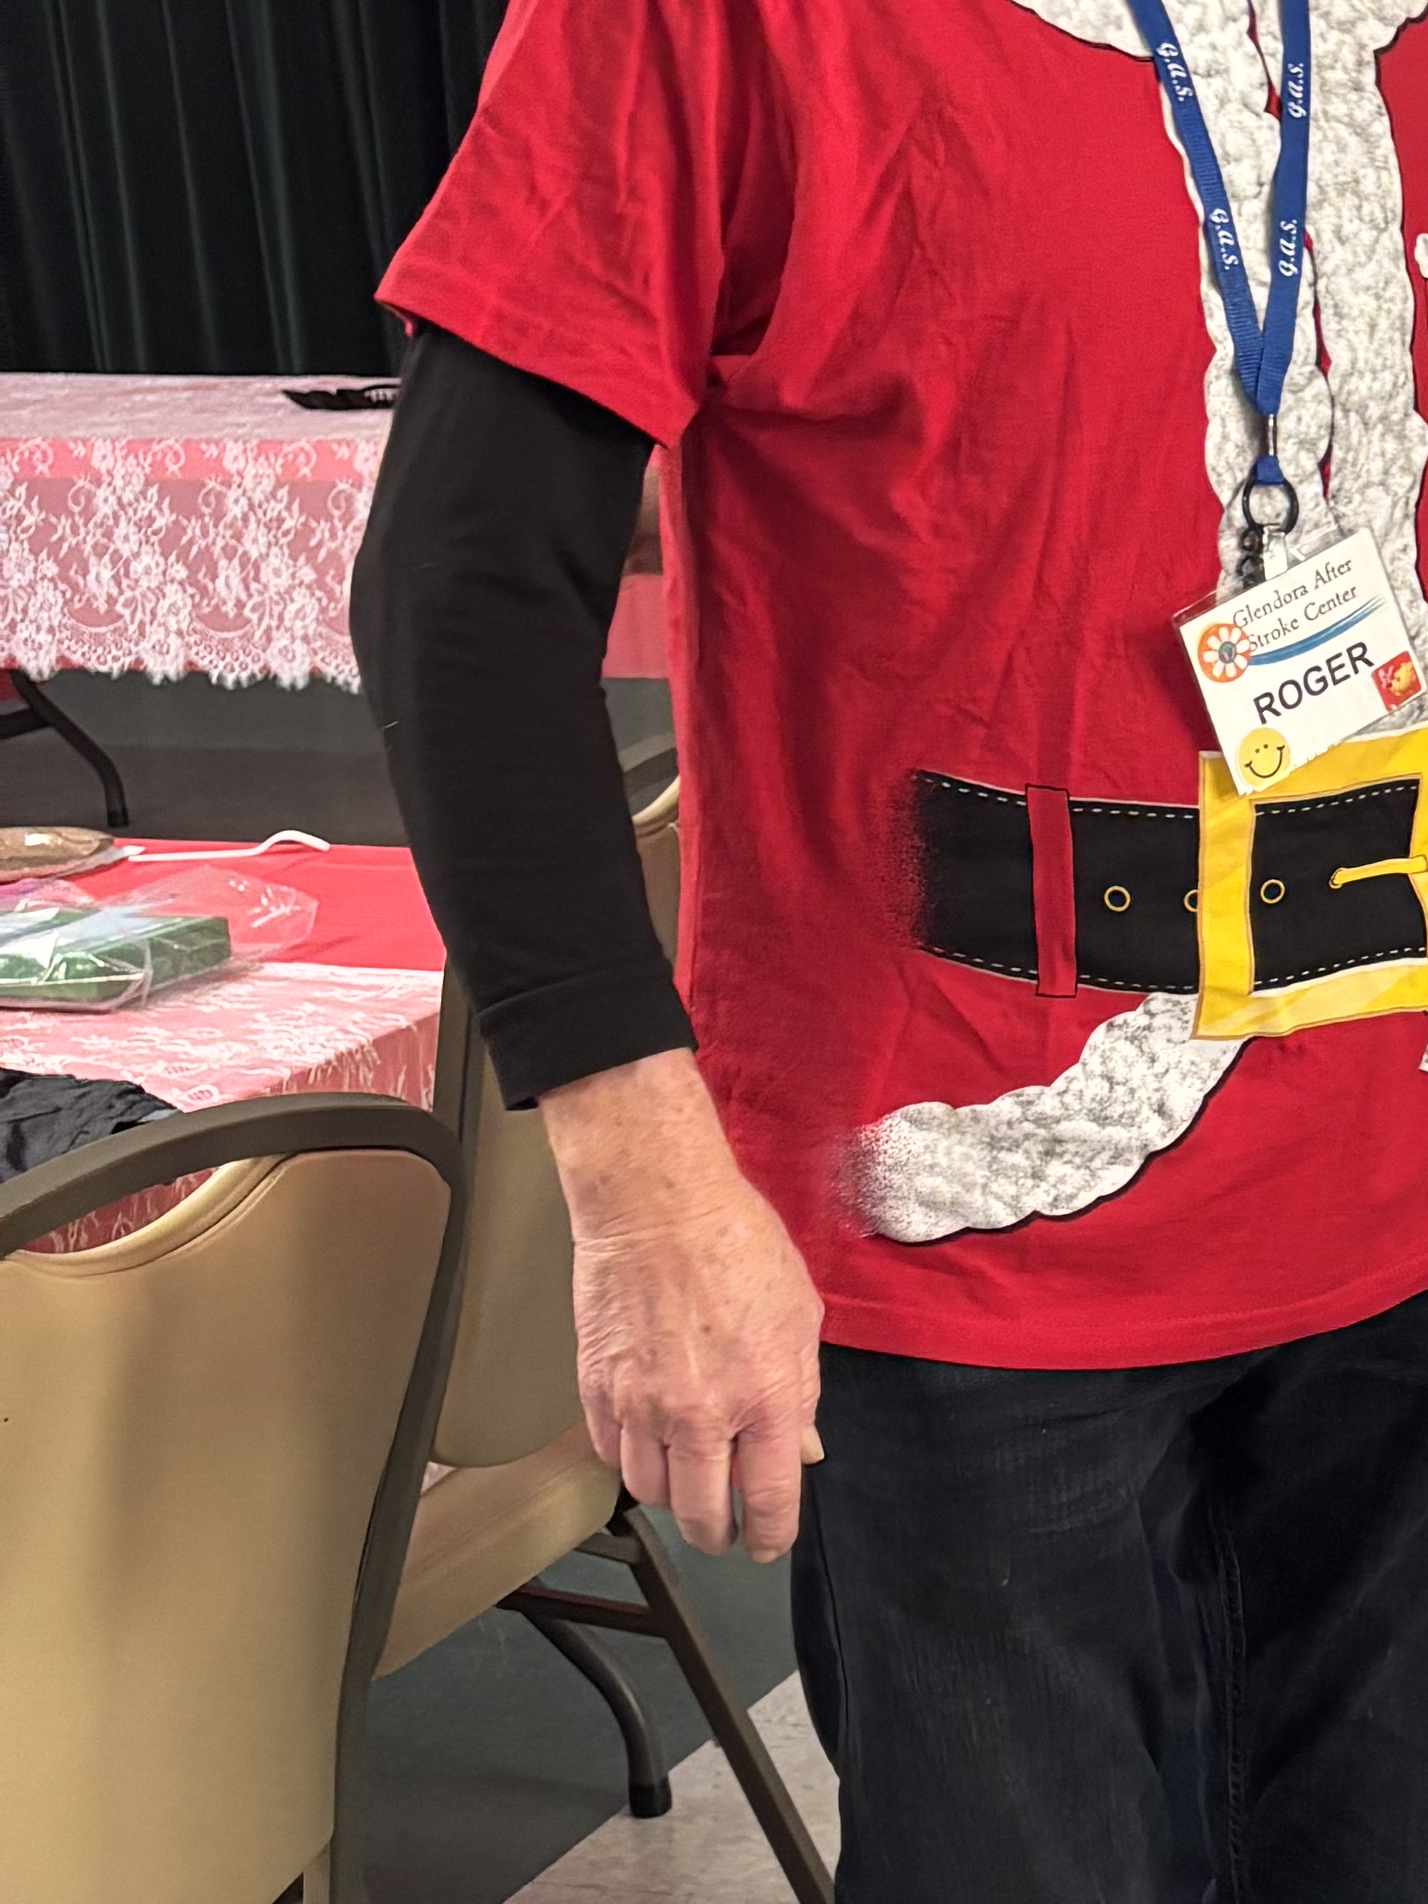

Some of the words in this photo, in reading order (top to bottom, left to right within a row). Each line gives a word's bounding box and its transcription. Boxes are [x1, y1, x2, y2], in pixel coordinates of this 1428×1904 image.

[1232, 583, 1309, 630] Glendora
[1314, 558, 1352, 590] After
[1249, 617, 1300, 652] Stroke
[1304, 585, 1357, 622] Center
[1253, 641, 1375, 725] ROGER
